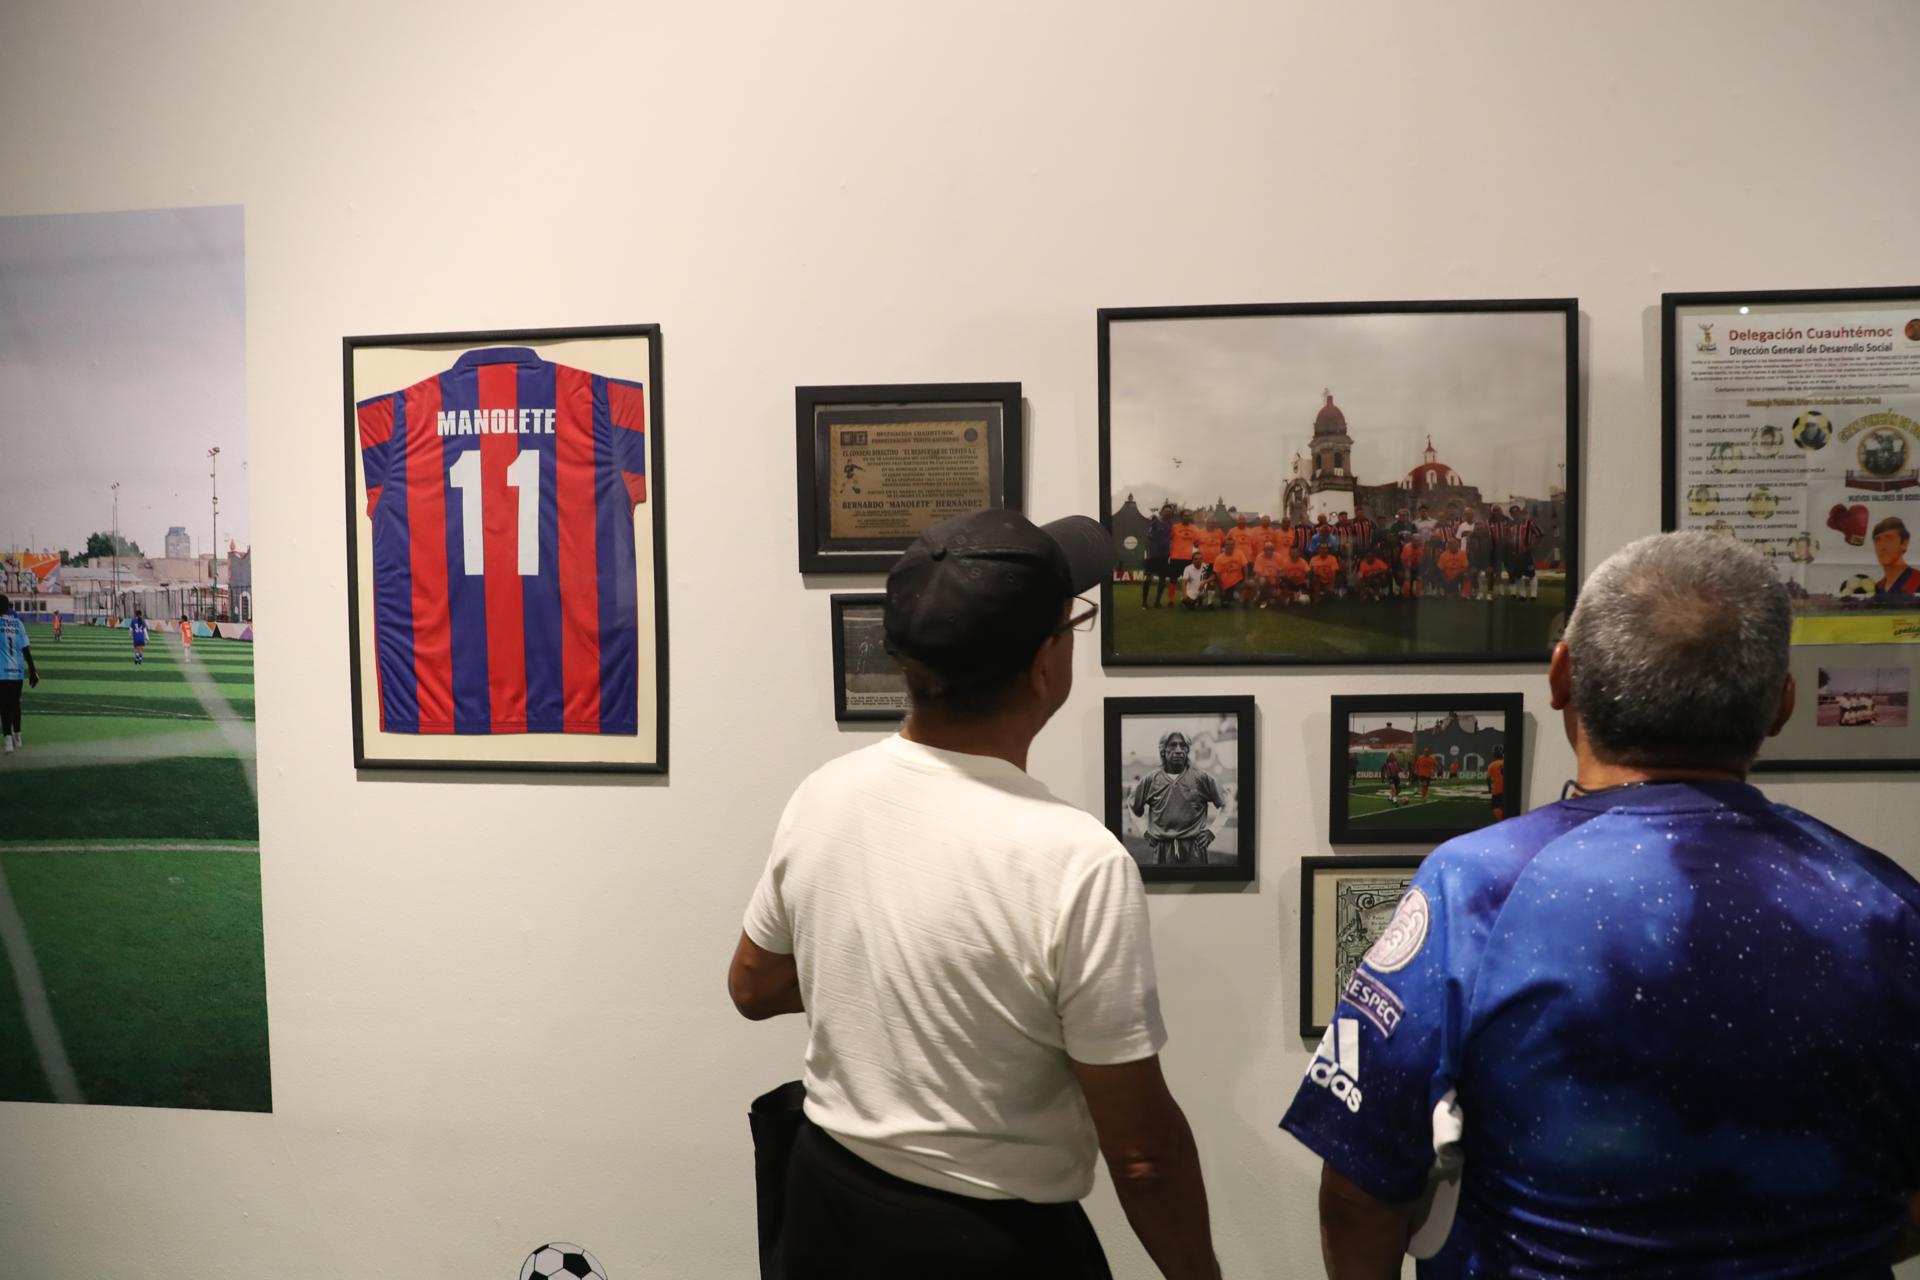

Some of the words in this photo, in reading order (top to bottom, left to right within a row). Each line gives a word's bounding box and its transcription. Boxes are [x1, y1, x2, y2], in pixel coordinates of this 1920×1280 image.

[1729, 327, 1802, 343] Delegación
[1807, 326, 1893, 340] Cuauhtémoc
[1729, 344, 1770, 356] Dirección
[1772, 344, 1805, 355] General
[1806, 344, 1818, 354] de
[1819, 343, 1864, 354] Desarrollo
[1866, 342, 1893, 352] Social
[437, 408, 556, 436] MANOLETE
[450, 449, 540, 576] 11
[842, 501, 884, 510] BERNARDO
